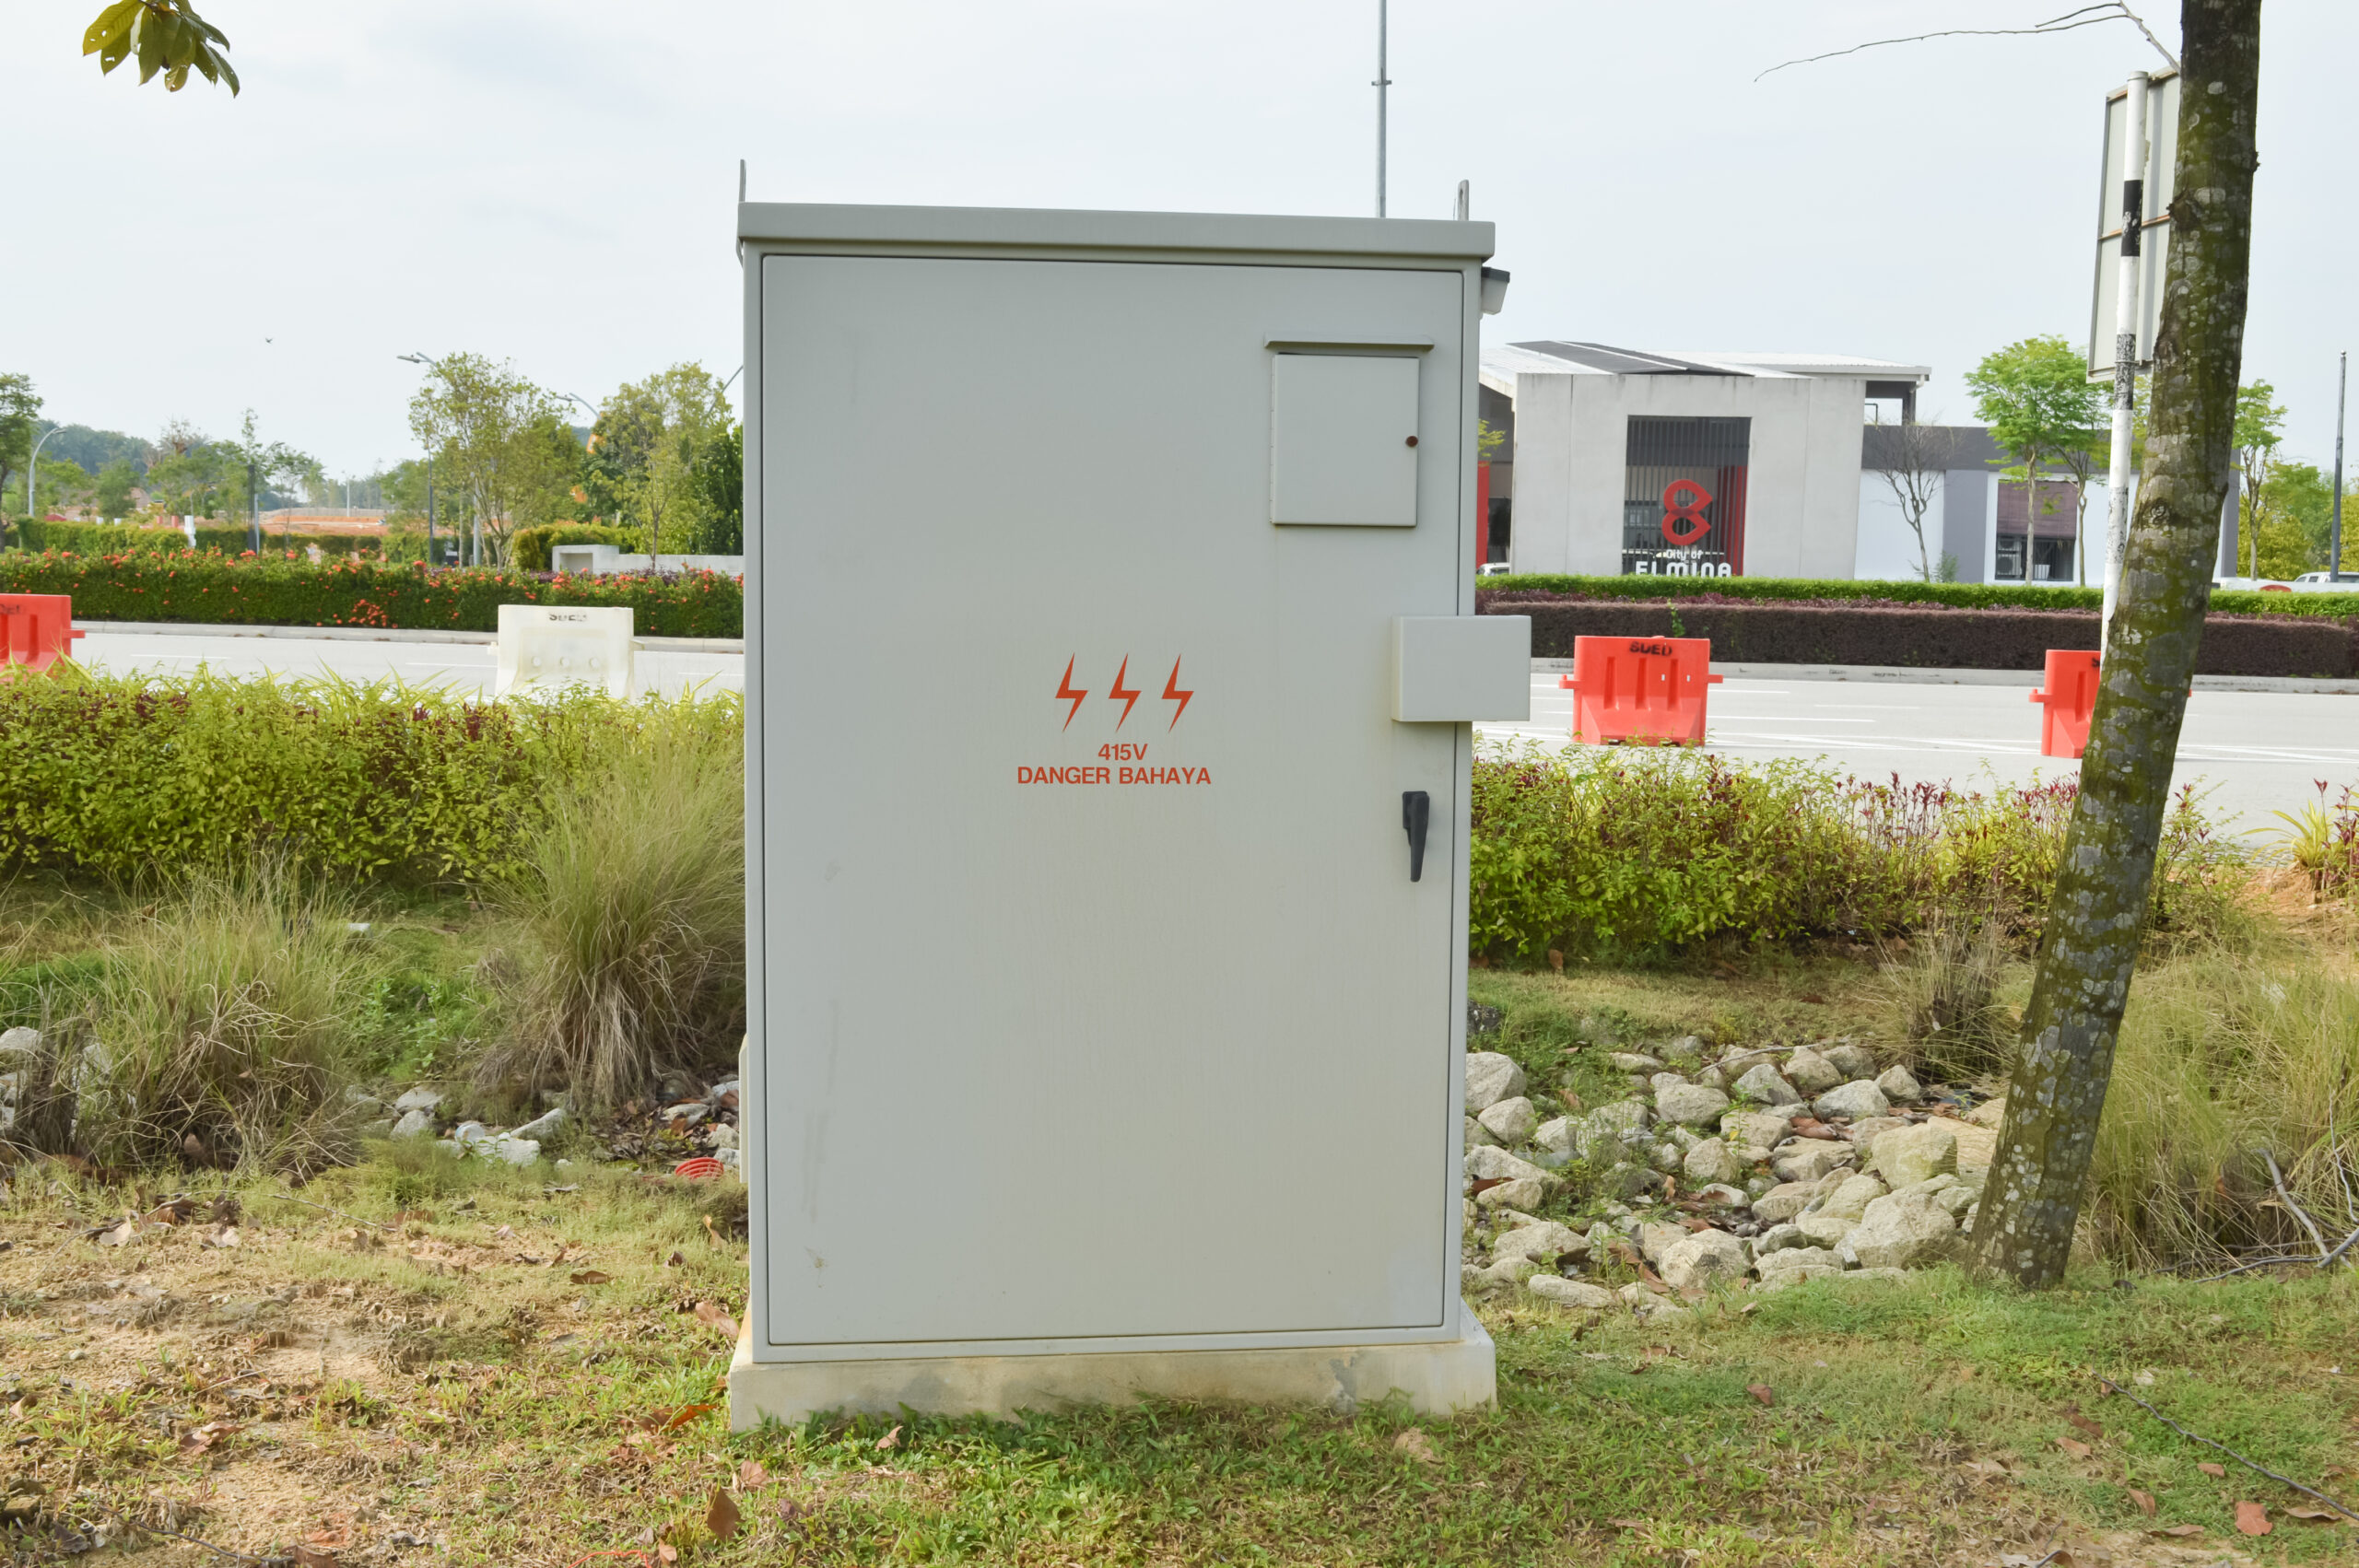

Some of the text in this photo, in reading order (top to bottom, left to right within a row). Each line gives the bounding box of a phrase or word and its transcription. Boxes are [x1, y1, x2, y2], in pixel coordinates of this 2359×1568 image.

[1666, 548, 1704, 560] City of
[1097, 743, 1148, 761] 415V
[1017, 766, 1212, 785] DANGER BAHAYA
